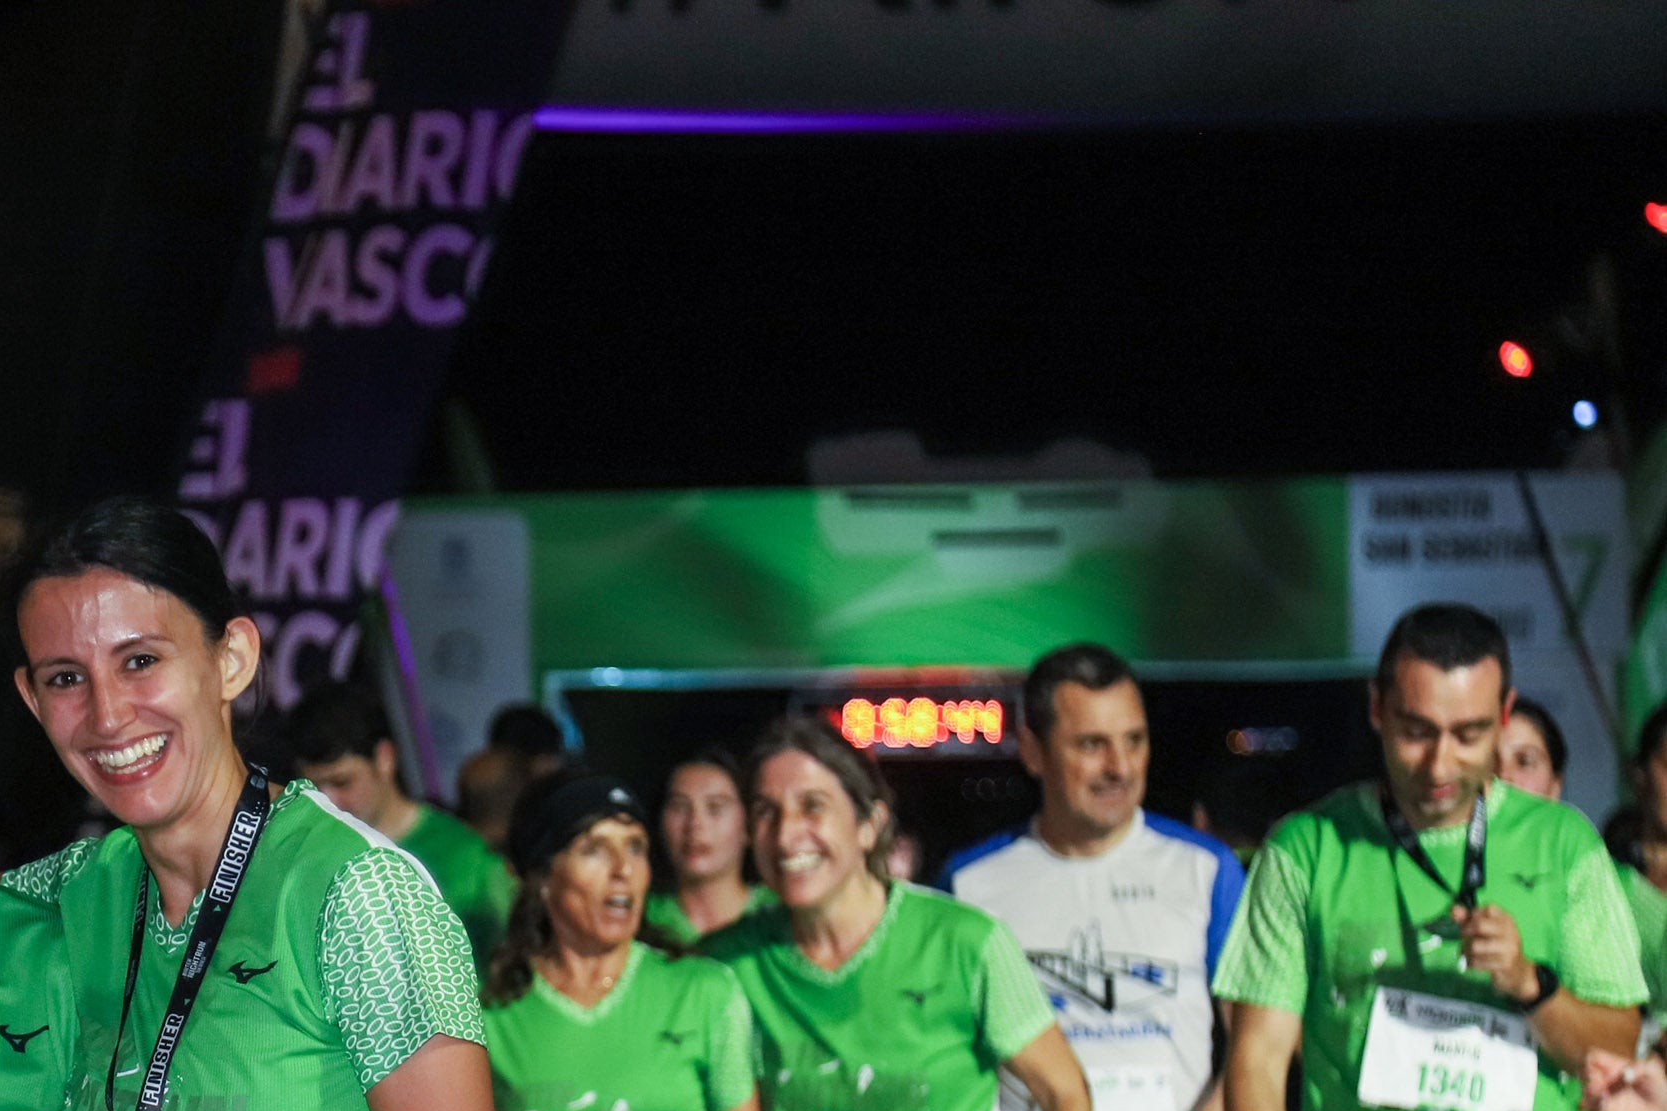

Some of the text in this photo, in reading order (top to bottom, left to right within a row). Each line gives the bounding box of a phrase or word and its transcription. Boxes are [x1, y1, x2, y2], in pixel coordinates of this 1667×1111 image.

[263, 223, 493, 331] VASC
[208, 811, 260, 903] FINISHER
[141, 1014, 184, 1106] FINISHER
